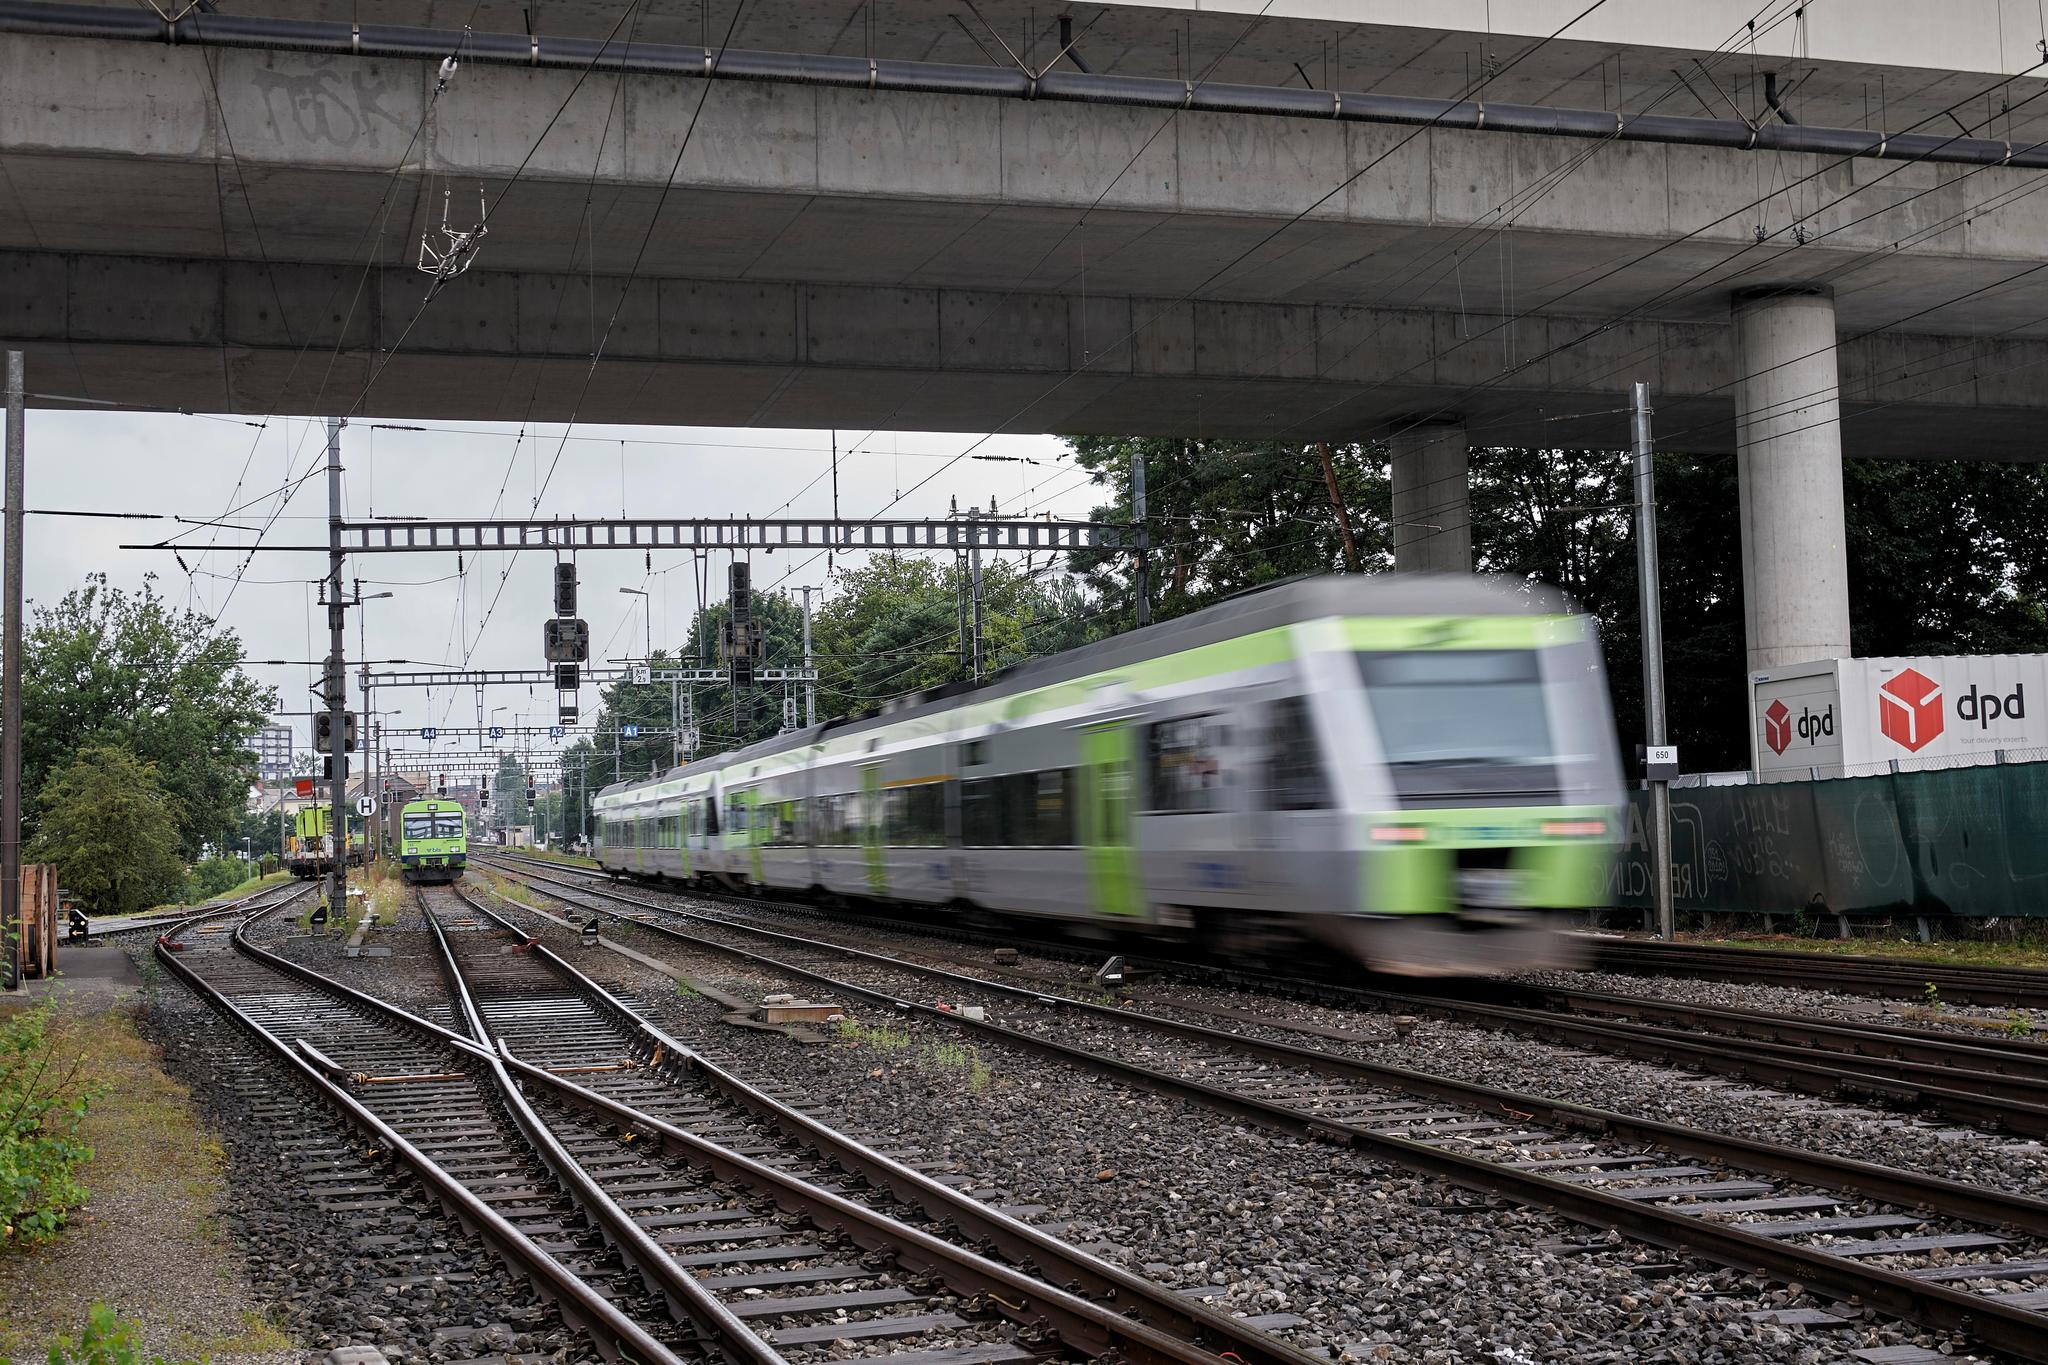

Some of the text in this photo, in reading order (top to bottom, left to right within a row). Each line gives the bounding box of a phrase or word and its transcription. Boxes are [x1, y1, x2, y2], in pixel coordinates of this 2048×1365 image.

[1957, 683, 2025, 730] dpd
[1797, 704, 1834, 746] dpd
[424, 729, 435, 738] A4
[490, 728, 503, 737] A3
[551, 728, 563, 737] A2
[625, 727, 637, 736] A1
[1655, 751, 1669, 759] 650
[361, 799, 372, 814] H
